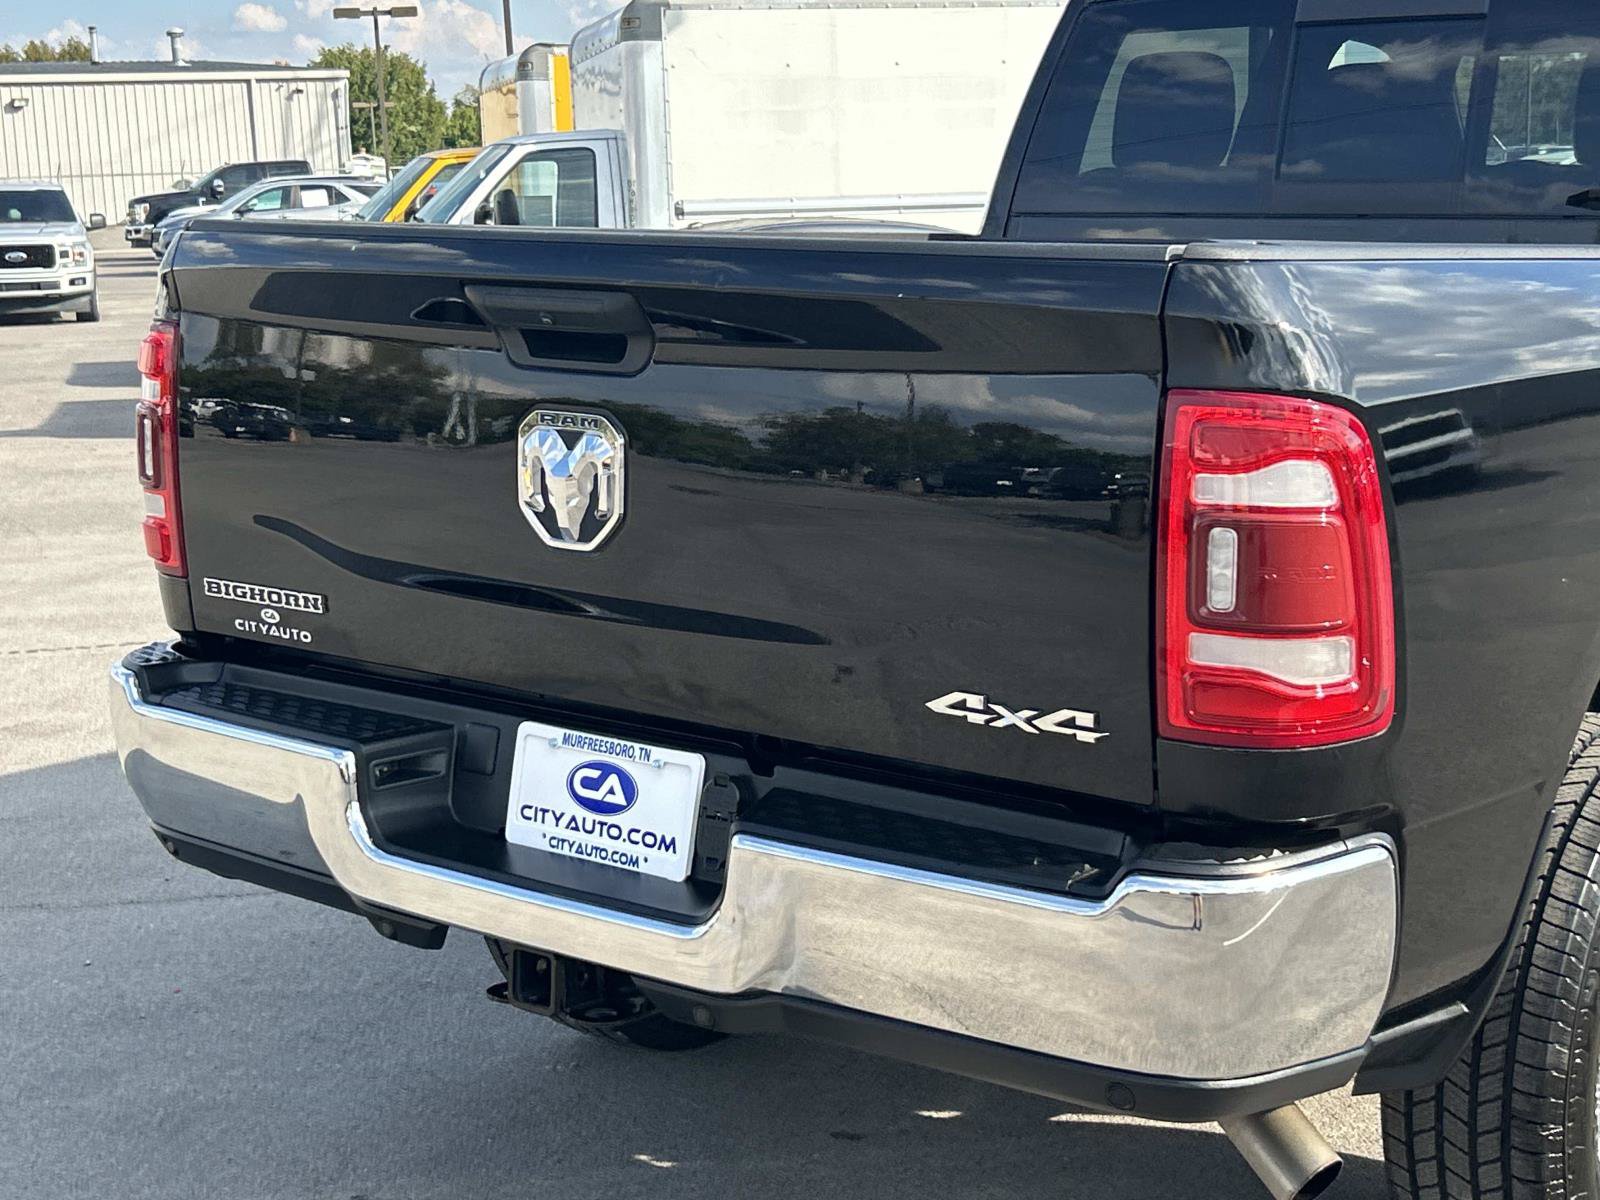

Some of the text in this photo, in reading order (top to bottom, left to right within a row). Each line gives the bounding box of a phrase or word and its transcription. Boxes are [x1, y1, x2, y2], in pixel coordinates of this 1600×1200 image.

[539, 413, 599, 428] RAM
[204, 577, 323, 613] BIGHORN
[235, 619, 312, 643] CITYAUTO
[562, 732, 652, 763] MURFREESBORO, TN
[572, 767, 628, 806] CA
[520, 804, 677, 854] CITYAUTO.COM
[549, 836, 639, 868] CITYAUTO.COM
